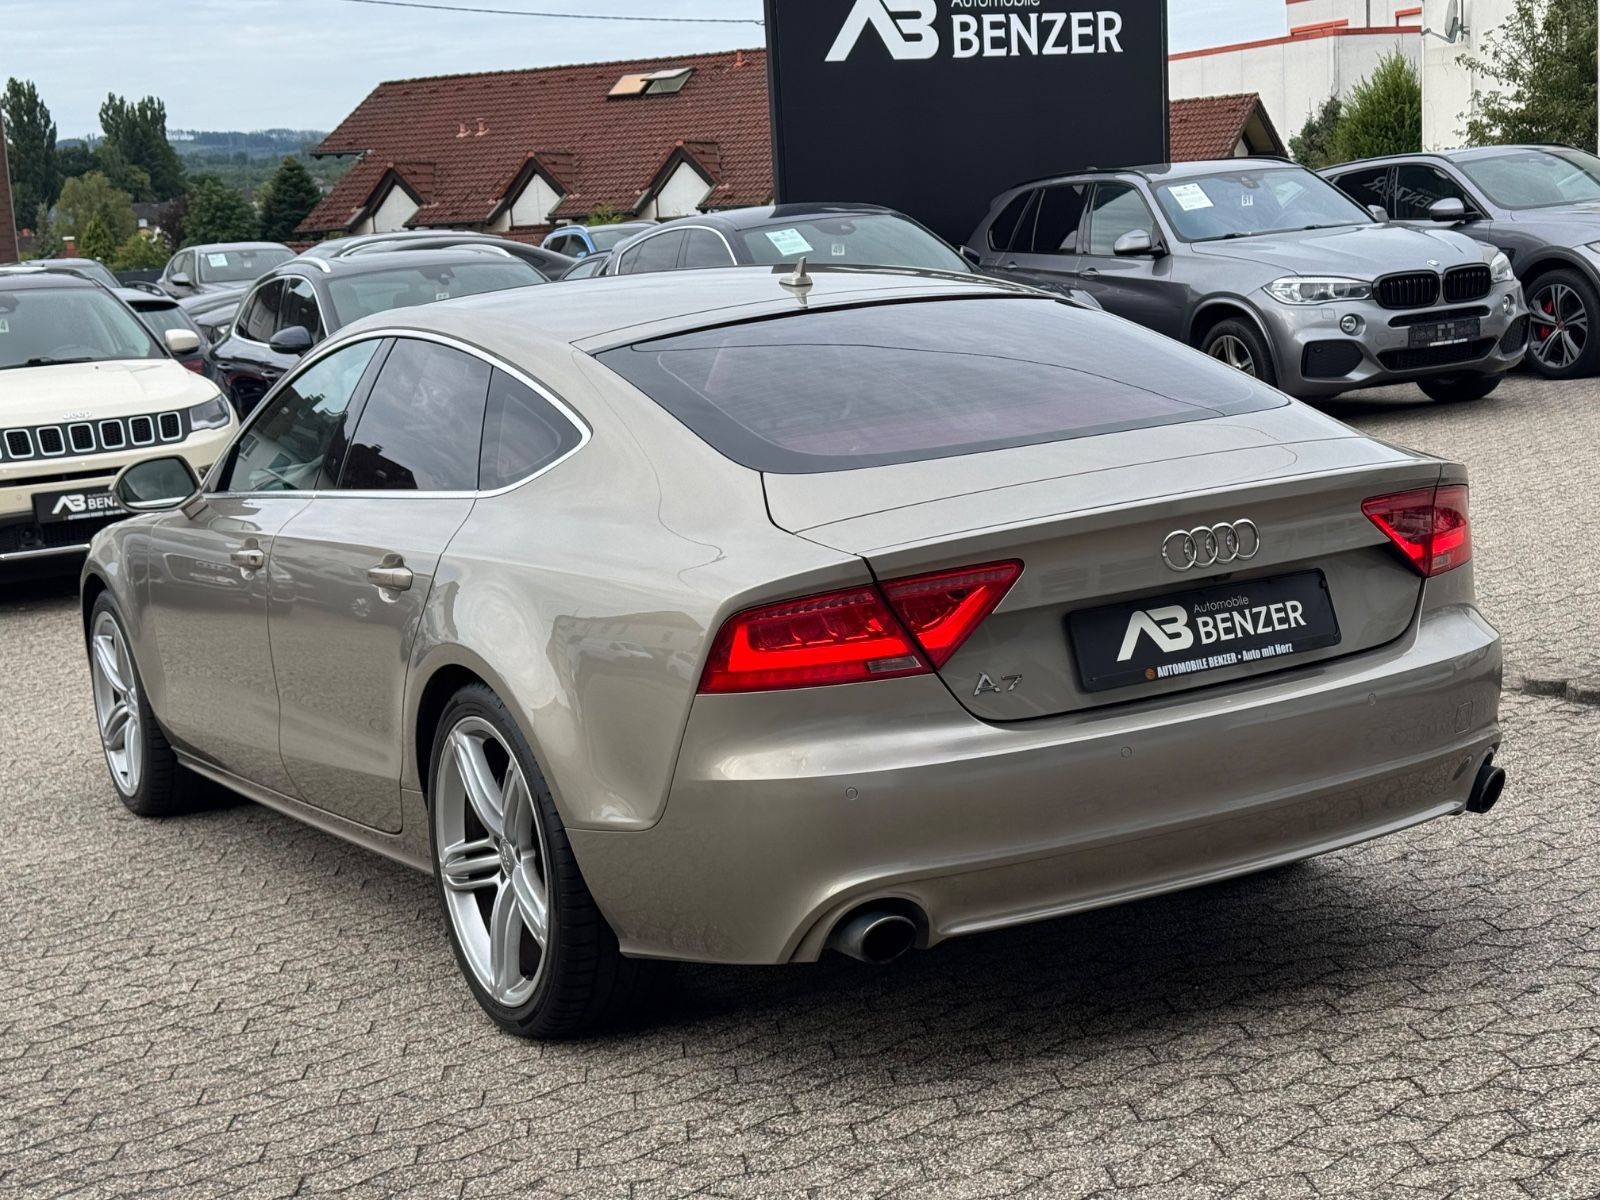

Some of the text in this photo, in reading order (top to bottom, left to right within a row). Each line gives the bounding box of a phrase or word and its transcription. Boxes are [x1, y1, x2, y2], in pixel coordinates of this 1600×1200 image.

[951, 11, 1123, 59] BENZER
[51, 494, 87, 515] AB
[1193, 595, 1249, 613] Automobile
[1117, 604, 1194, 662] AB
[1196, 600, 1307, 645] BENZER
[1157, 643, 1293, 678] AUTOMOBILE BENZER Auto mit Herz
[973, 672, 1022, 696] A7
